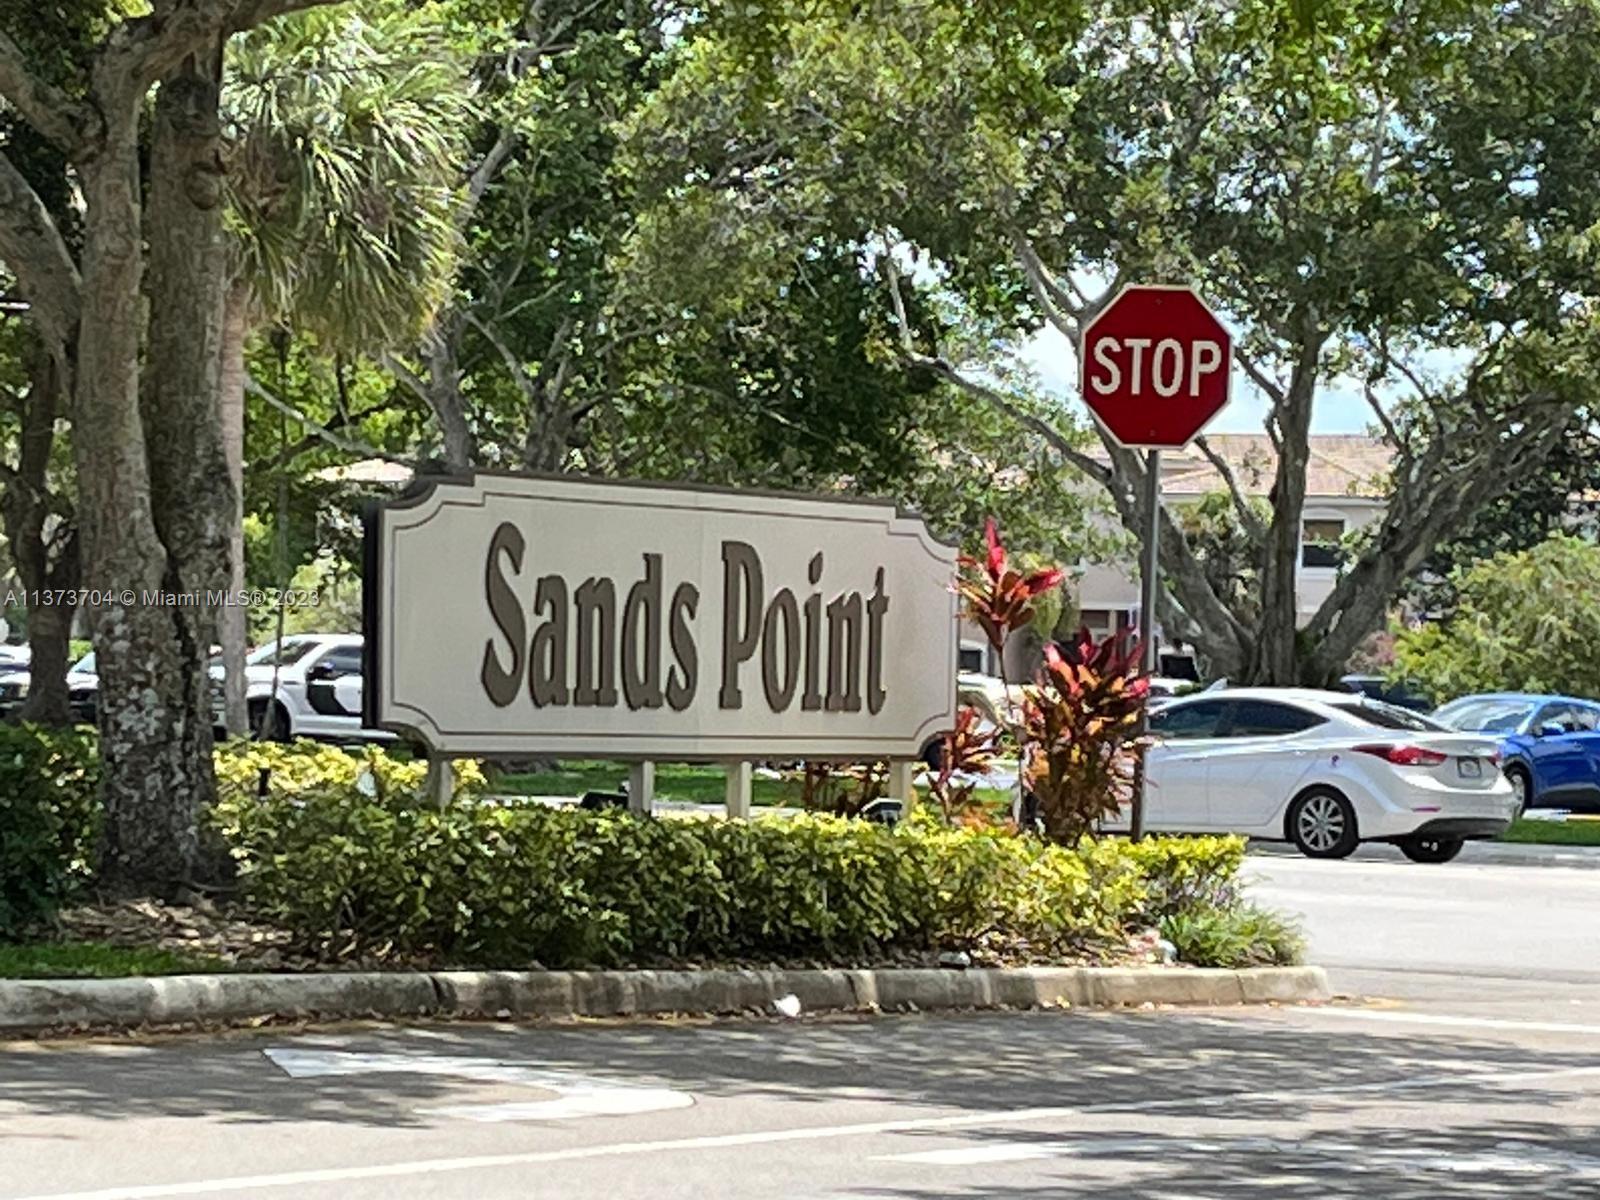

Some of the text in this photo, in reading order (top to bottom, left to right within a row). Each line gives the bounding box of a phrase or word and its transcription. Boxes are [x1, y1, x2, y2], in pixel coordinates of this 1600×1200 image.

[1091, 336, 1222, 397] STOP
[480, 521, 891, 716] Sands Point
